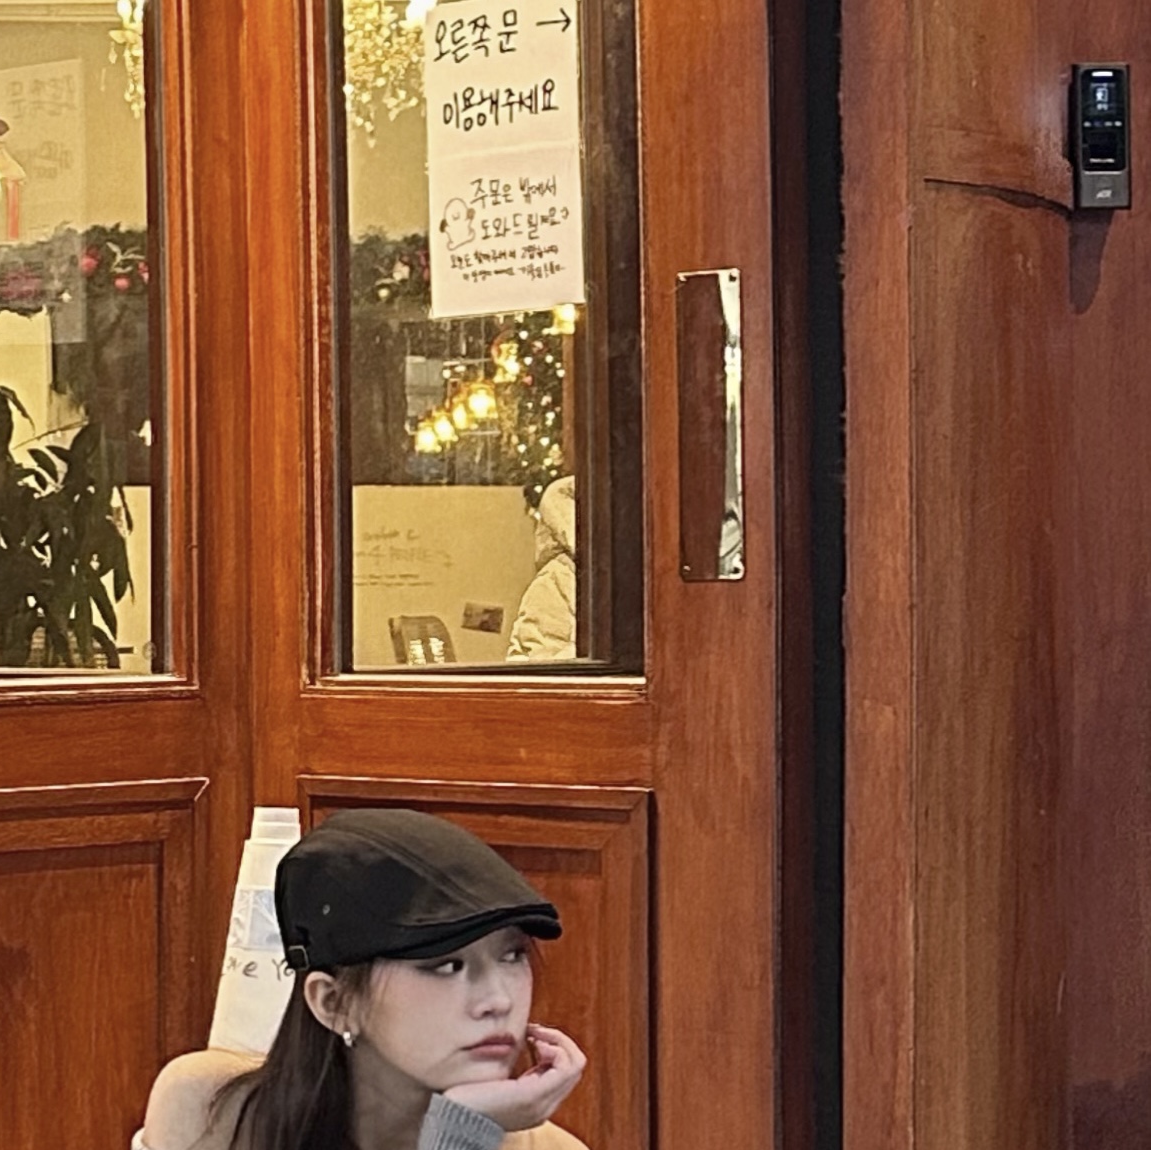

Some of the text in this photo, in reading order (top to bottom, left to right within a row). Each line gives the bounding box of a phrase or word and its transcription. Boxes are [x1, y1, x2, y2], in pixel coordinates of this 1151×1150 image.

[433, 9, 518, 63] 오른쪽 문
[443, 78, 559, 132] 이용해주세요
[470, 178, 513, 209] 주문은
